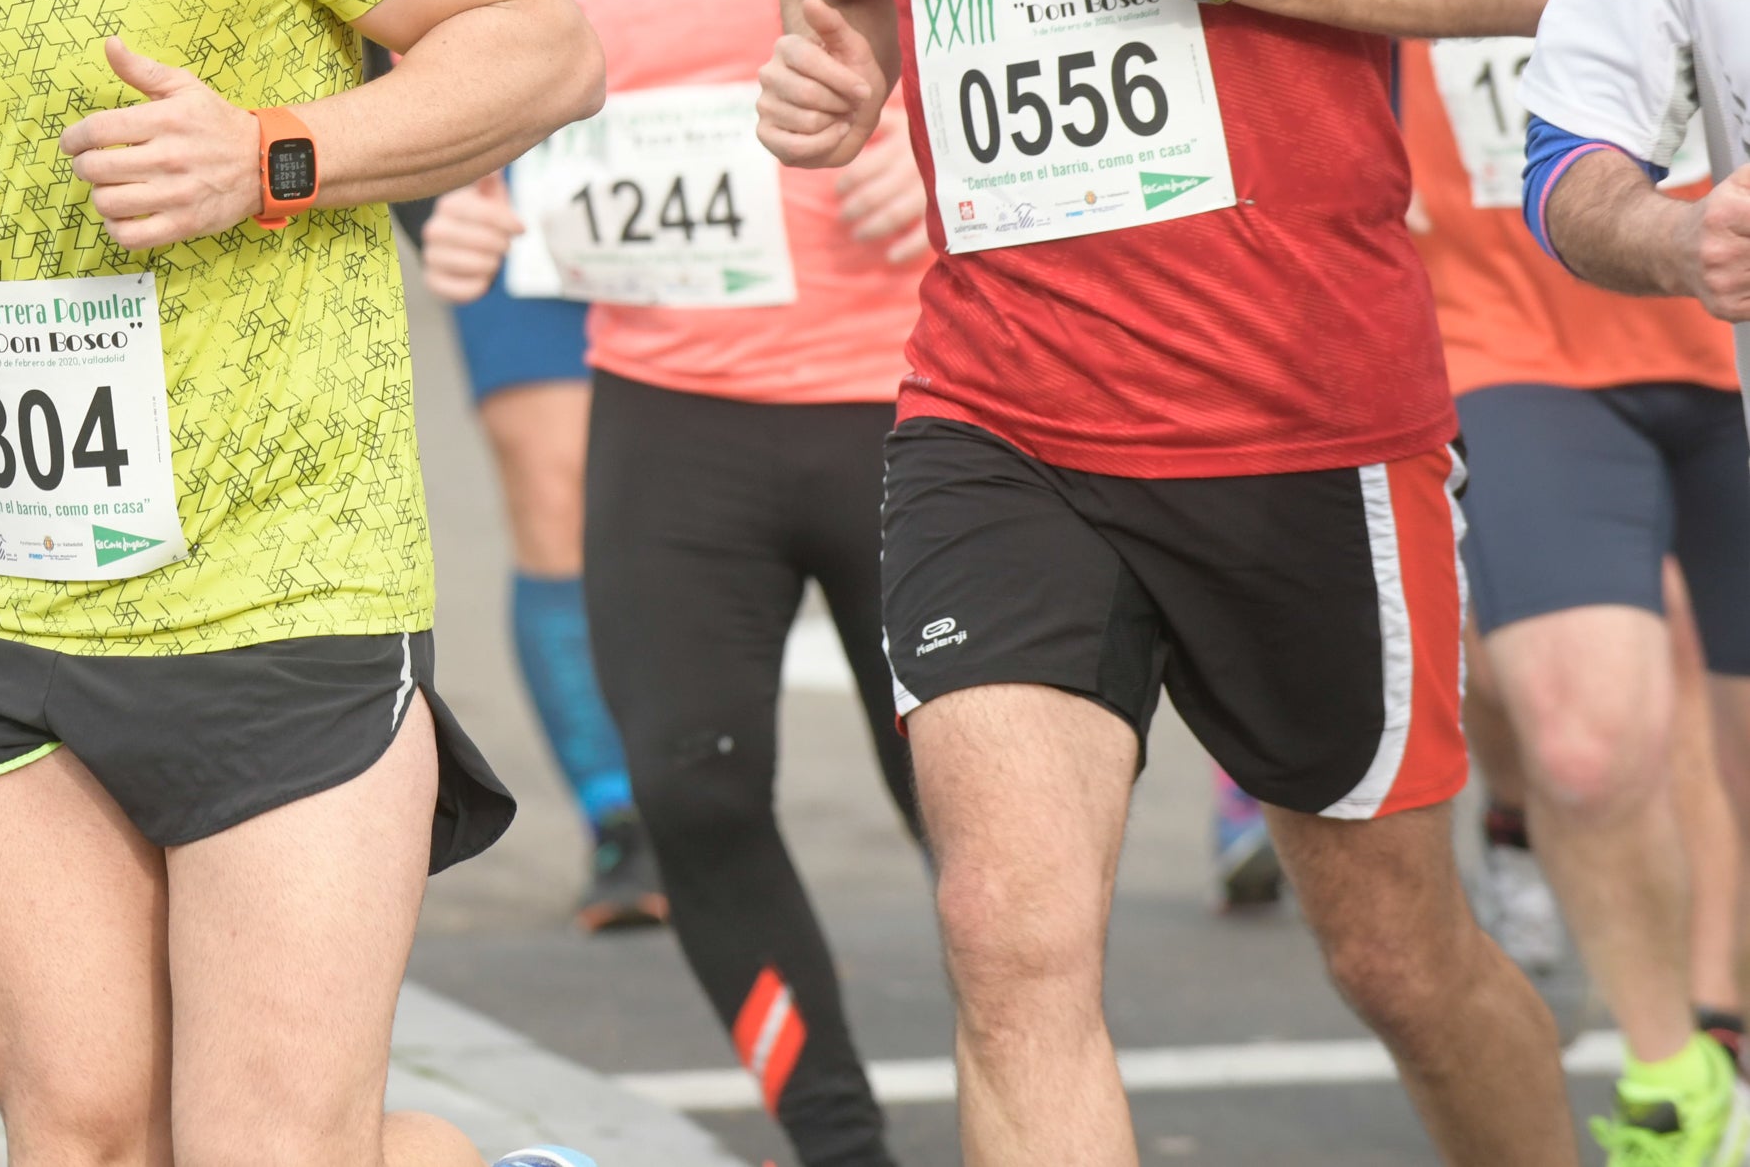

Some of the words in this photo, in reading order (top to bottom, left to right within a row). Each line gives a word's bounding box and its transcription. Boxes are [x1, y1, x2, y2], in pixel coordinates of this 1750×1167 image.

[959, 41, 1169, 165] 0556
[1019, 171, 1034, 182] en
[1037, 166, 1048, 180] el
[1098, 155, 1135, 170] como
[1139, 151, 1155, 162] en
[572, 171, 744, 244] 1244
[53, 293, 147, 327] Popular
[4, 358, 14, 367] de
[15, 357, 46, 367] febrero
[47, 357, 57, 367] de
[58, 357, 81, 367] 2020,
[82, 354, 125, 365] Valladolid
[5, 500, 14, 514] el
[16, 500, 52, 518] barrio,
[55, 504, 89, 516] como
[93, 503, 109, 515] en
